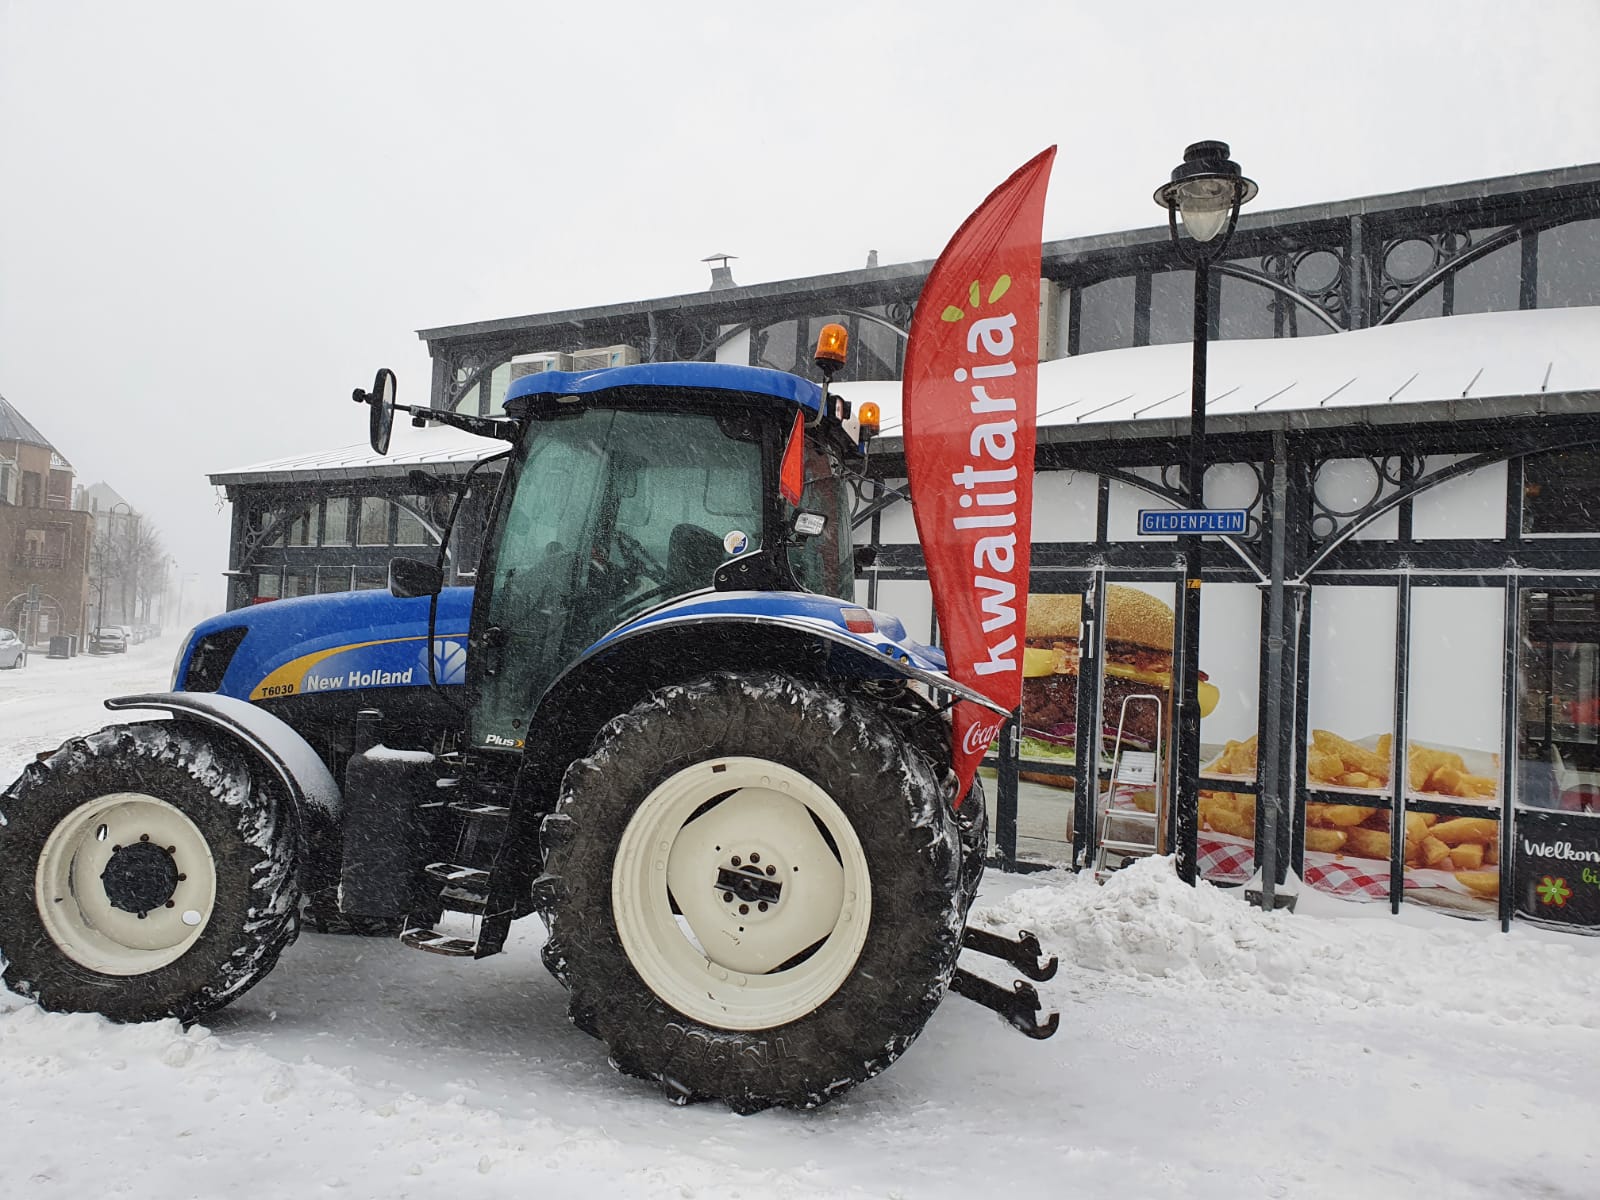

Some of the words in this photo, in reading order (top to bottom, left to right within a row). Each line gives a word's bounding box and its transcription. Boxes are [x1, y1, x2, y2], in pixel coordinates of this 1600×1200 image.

[953, 312, 1018, 675] kwalitaria
[1145, 515, 1241, 529] GILDENPLEIN
[307, 675, 344, 691] New
[348, 668, 413, 687] Holland
[262, 684, 294, 697] T6030
[485, 733, 514, 746] Plus
